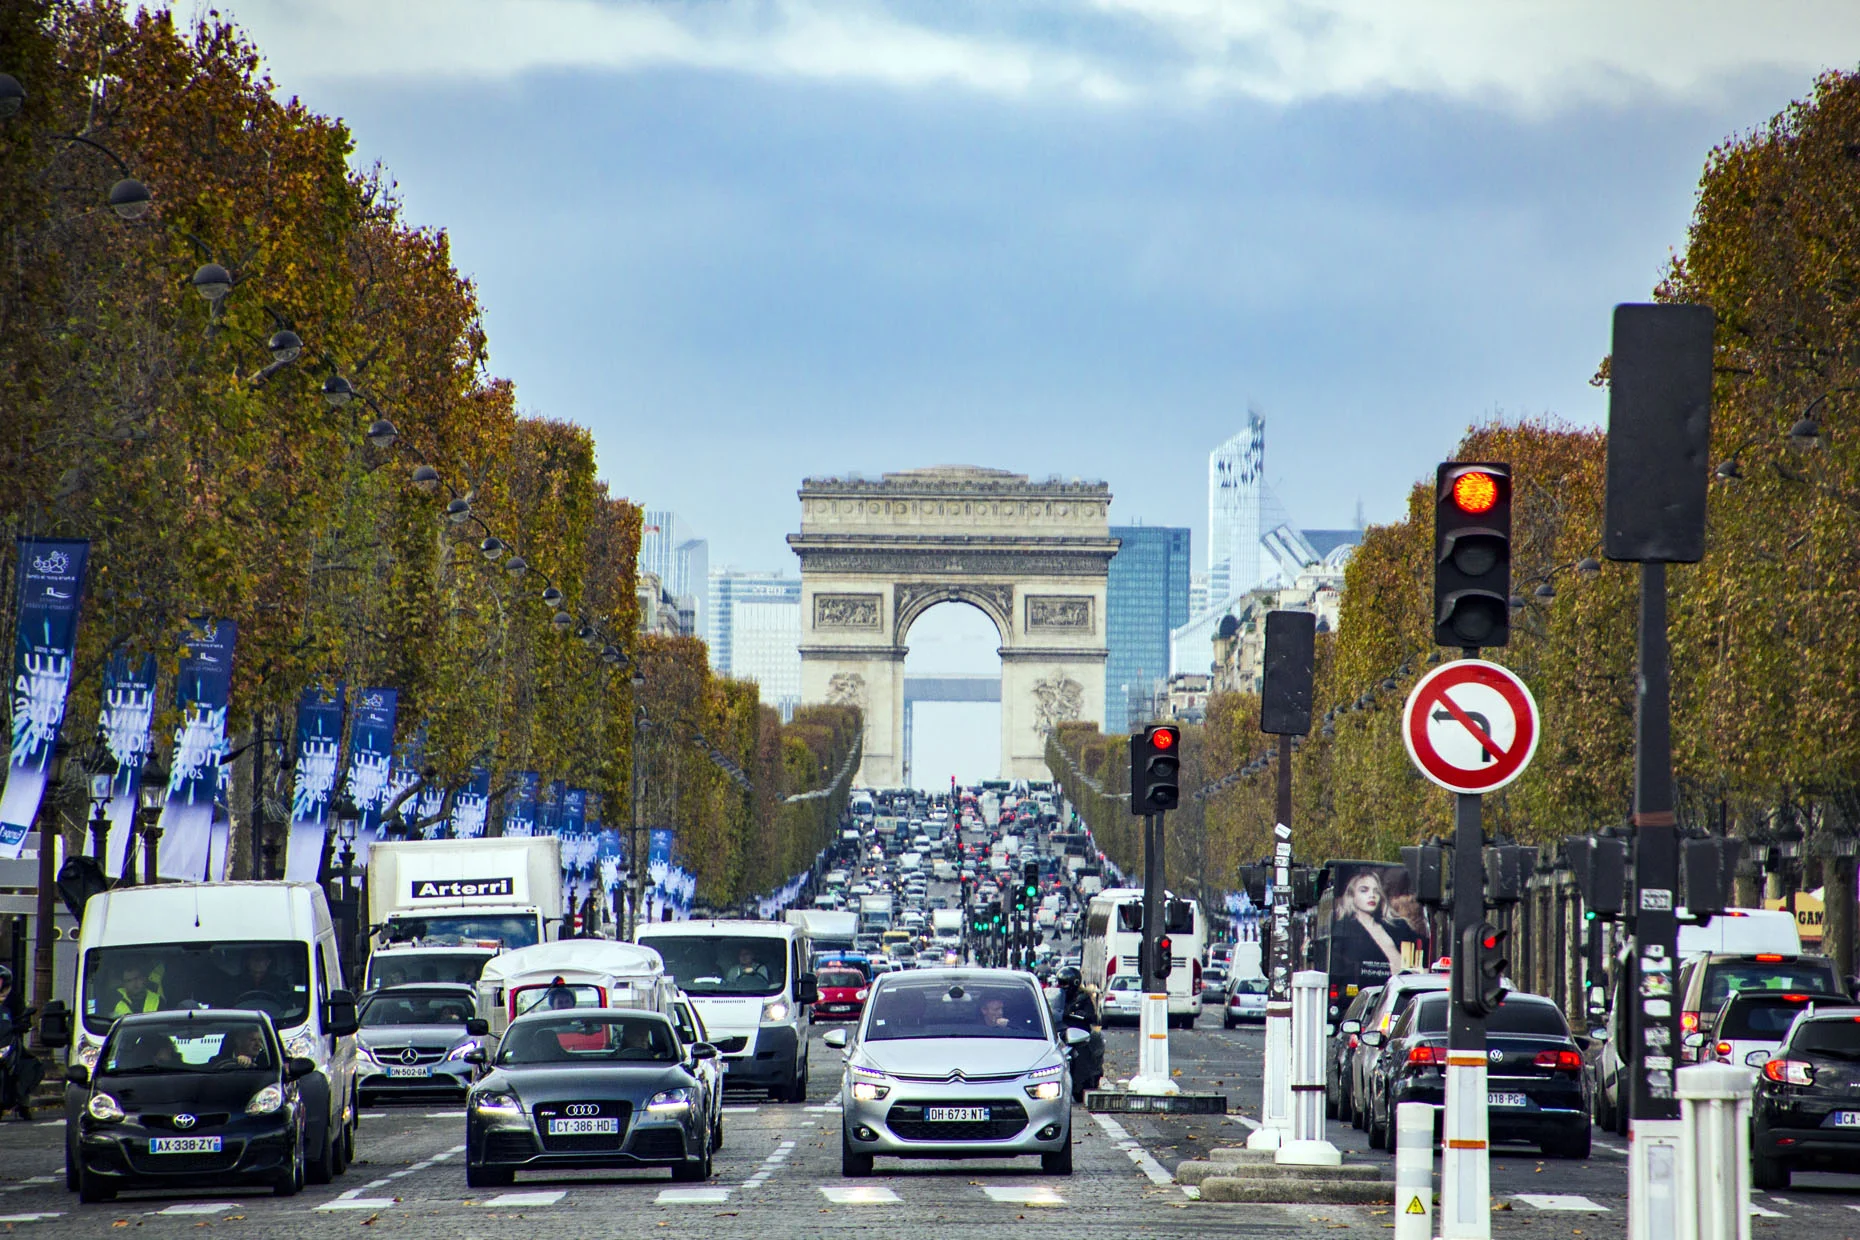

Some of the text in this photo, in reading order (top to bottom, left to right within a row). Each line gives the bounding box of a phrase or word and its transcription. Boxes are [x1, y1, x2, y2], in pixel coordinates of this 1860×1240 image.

[418, 880, 507, 896] Arterri
[931, 1109, 983, 1120] DH-673-NT
[556, 1120, 610, 1133] CY-386-HD
[157, 1139, 213, 1152] AX-338-ZY
